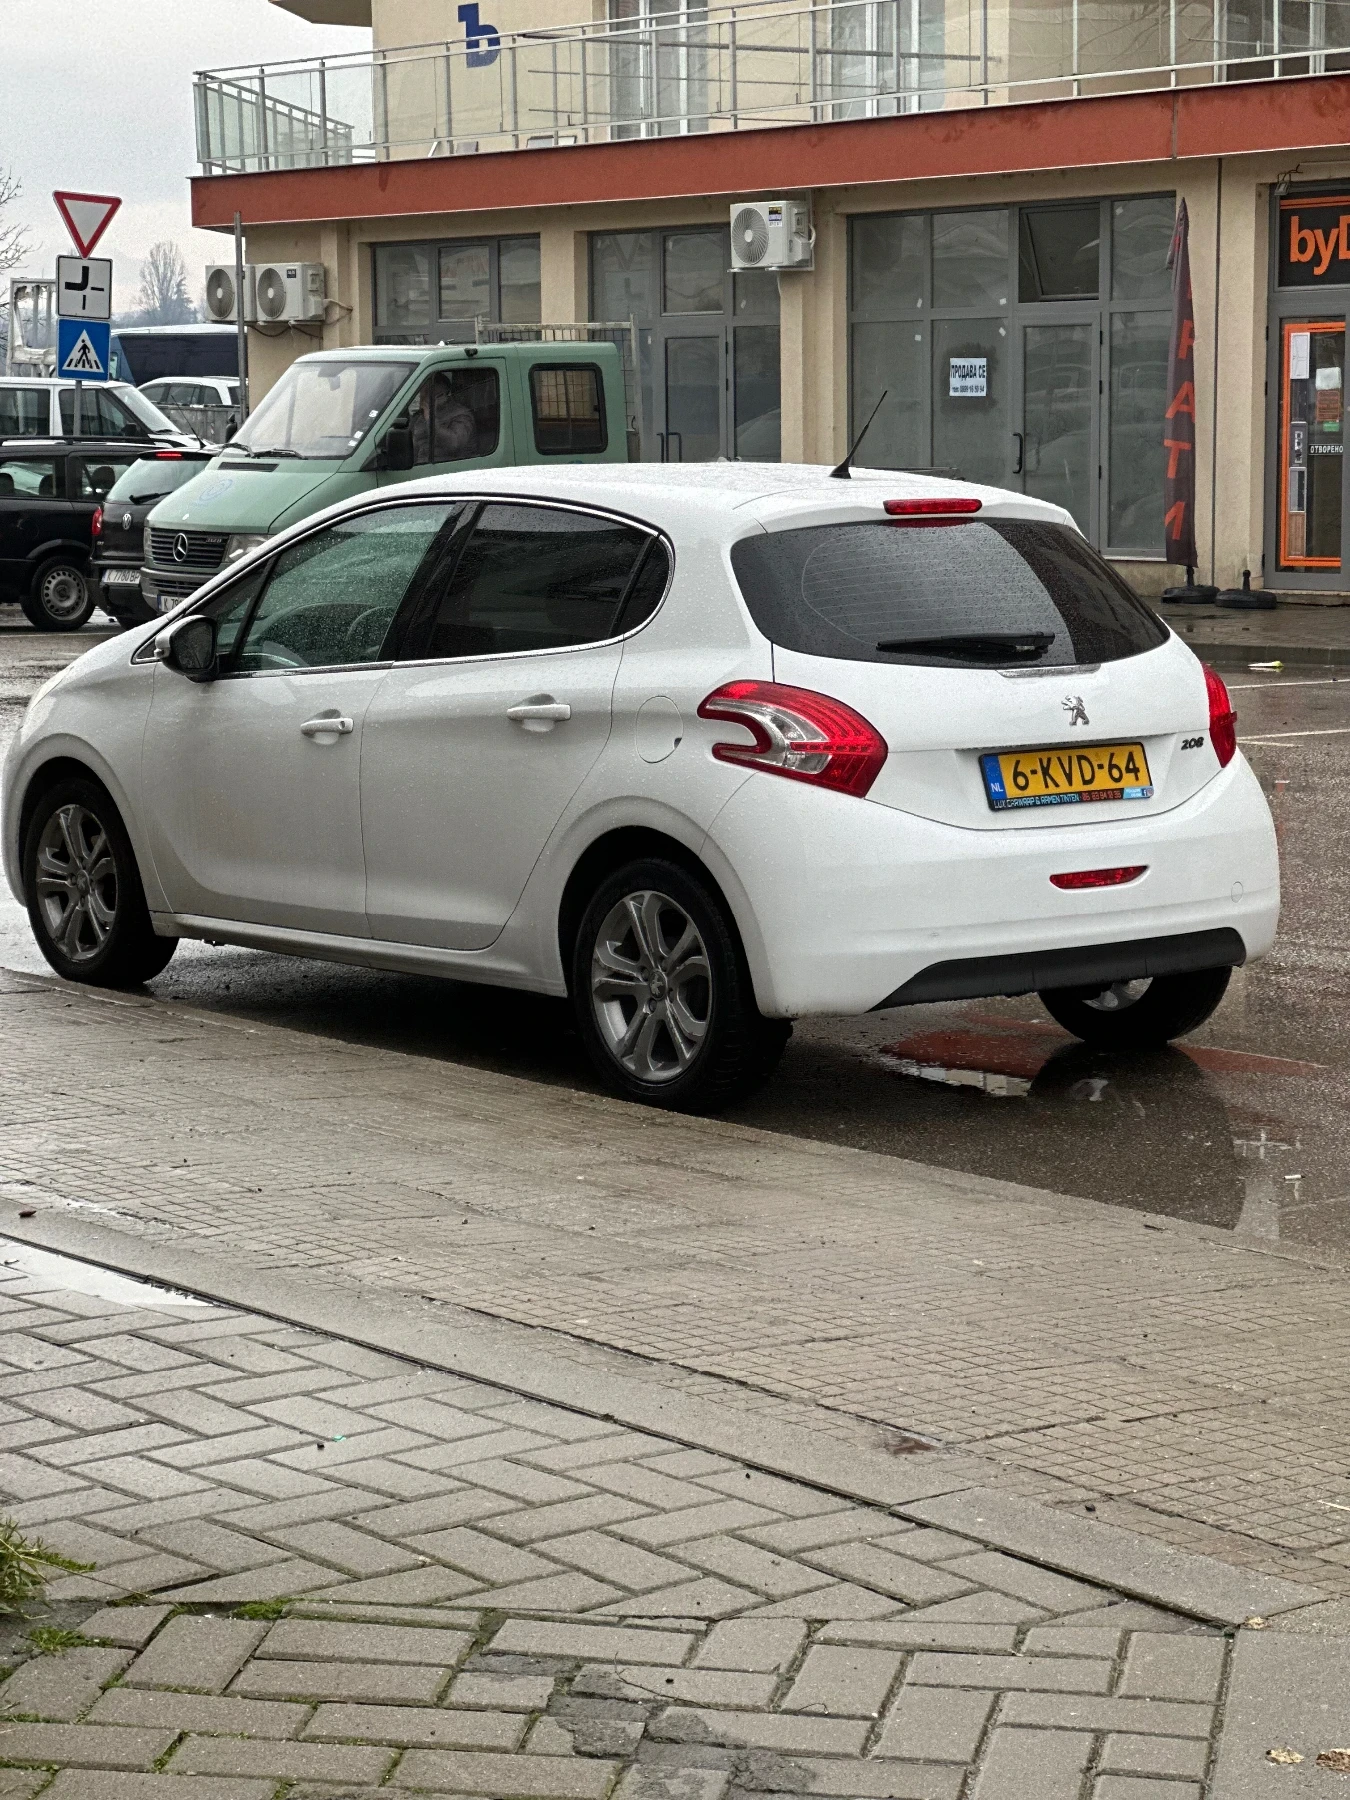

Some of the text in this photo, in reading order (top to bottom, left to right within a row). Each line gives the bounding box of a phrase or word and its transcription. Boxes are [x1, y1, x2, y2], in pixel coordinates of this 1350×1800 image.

[951, 364, 986, 381] ПРОДАВА СЕ
[1164, 277, 1196, 540] РАТИ
[1310, 445, 1344, 454] ОТВОРЕНО
[1181, 736, 1204, 750] 208
[1012, 751, 1140, 791] 6-KVD-64
[991, 782, 1004, 793] NL
